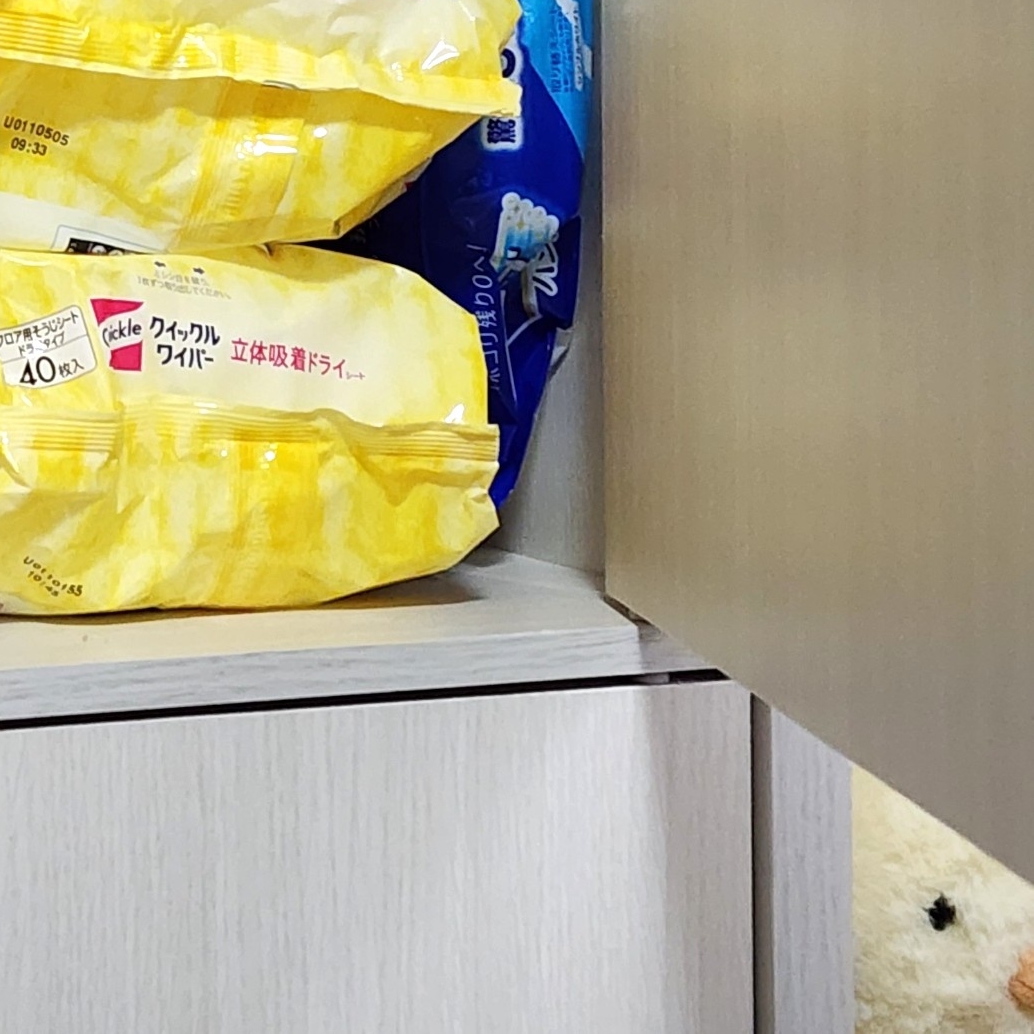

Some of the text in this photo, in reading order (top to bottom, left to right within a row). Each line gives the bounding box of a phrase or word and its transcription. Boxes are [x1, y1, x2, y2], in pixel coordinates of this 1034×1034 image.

[4, 116, 70, 146] U0110505
[11, 137, 48, 156] 09:33
[18, 330, 65, 357] ドラタイプ
[149, 316, 221, 346] クイックル
[19, 355, 85, 385] 40枚入
[157, 344, 214, 369] ワイパー
